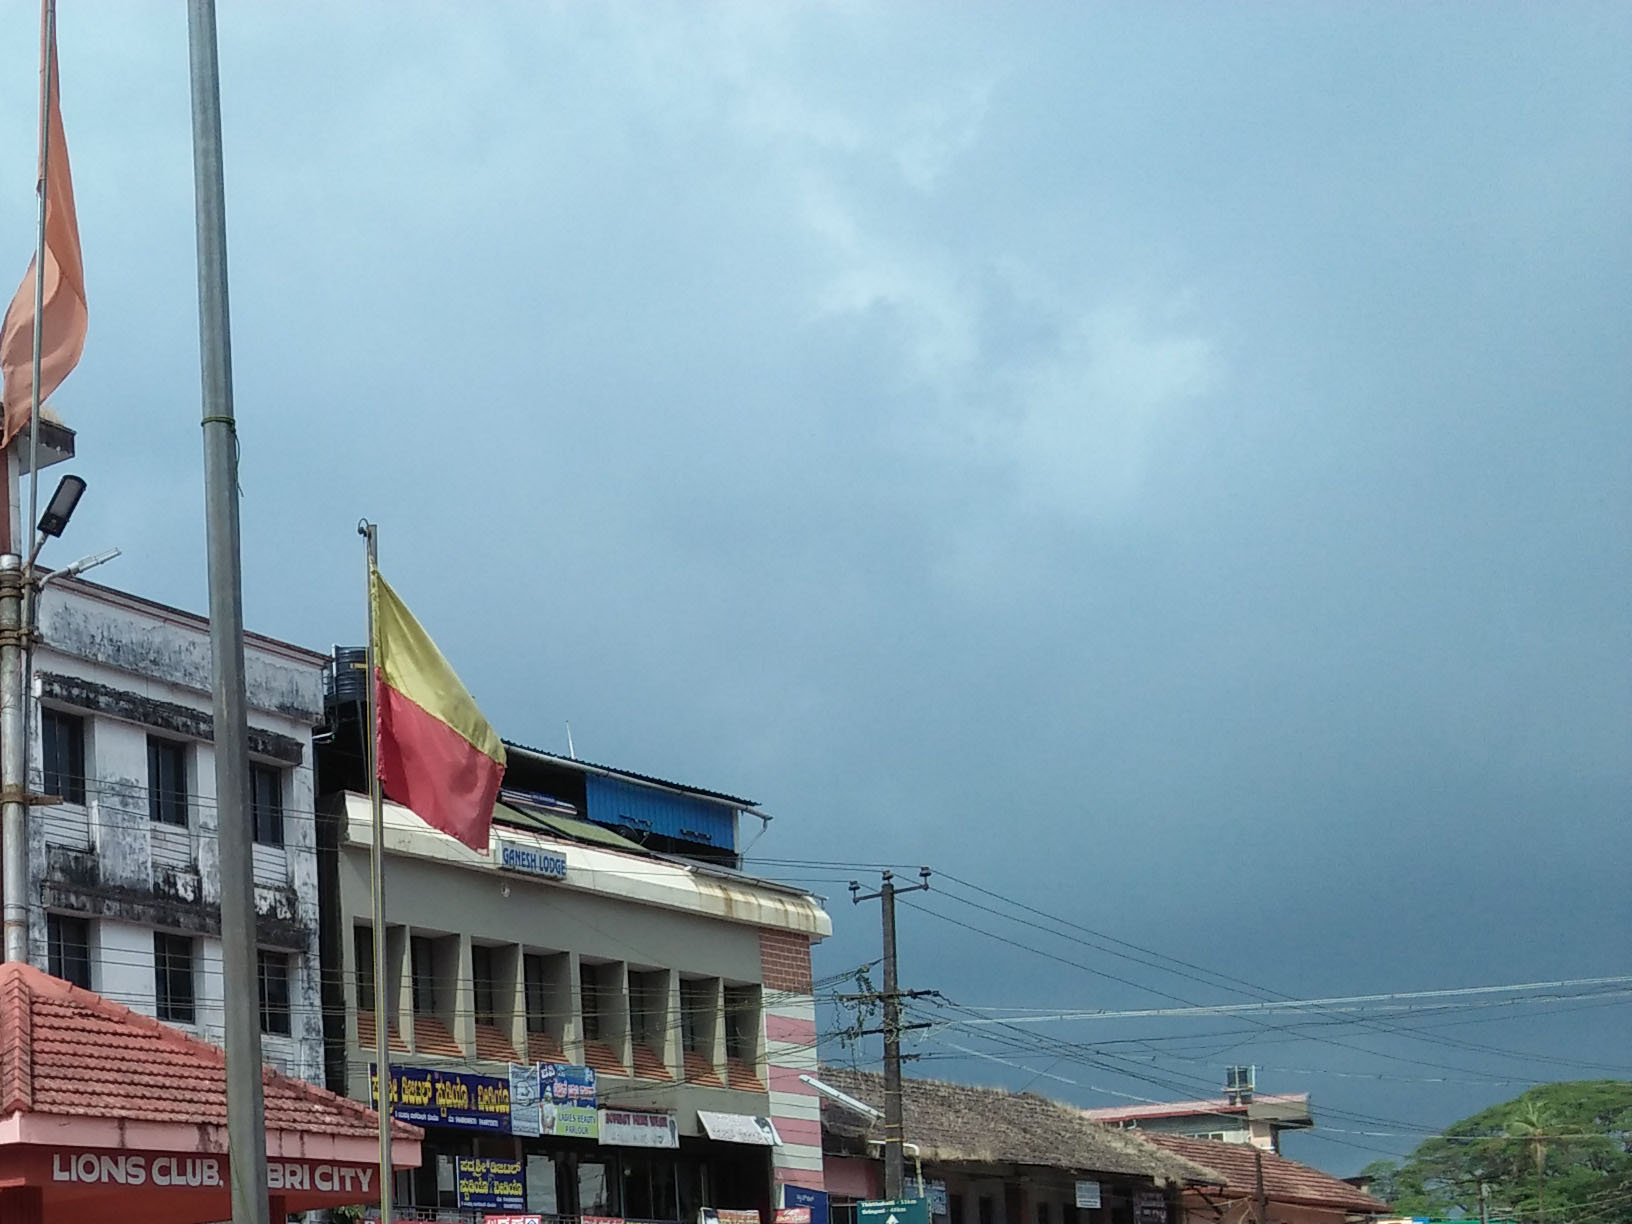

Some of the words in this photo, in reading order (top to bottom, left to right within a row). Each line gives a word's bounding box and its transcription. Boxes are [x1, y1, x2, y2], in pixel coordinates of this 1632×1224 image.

[503, 848, 536, 868] GANESH
[539, 855, 567, 876] LODGE
[52, 1153, 147, 1186] LIONS
[267, 1162, 311, 1191] BRI
[314, 1165, 373, 1193] CITY
